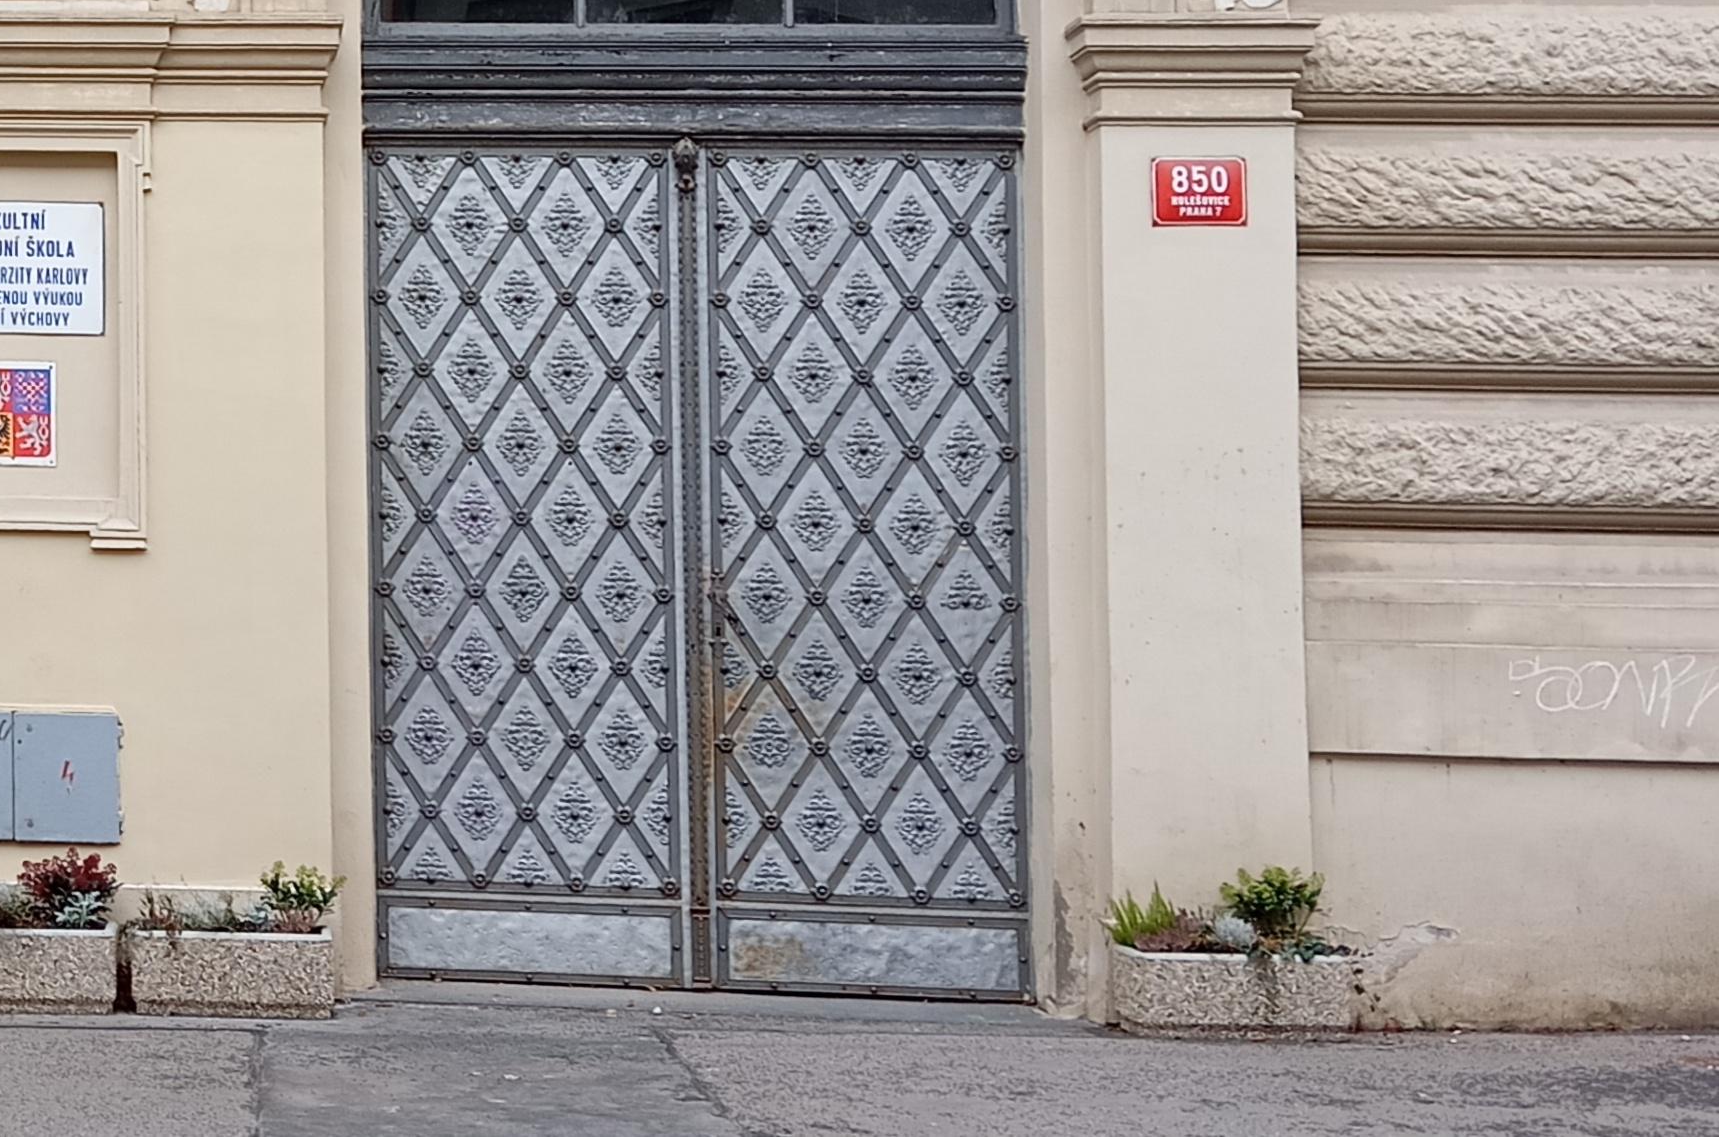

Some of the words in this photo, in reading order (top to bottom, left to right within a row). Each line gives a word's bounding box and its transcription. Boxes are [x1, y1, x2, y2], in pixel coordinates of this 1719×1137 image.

[1171, 165, 1229, 194] 850
[1179, 206, 1213, 217] PRAHA
[1215, 206, 1223, 217] 7
[26, 235, 76, 258] ŠKOLA
[36, 267, 89, 286] KARLOVY
[33, 288, 83, 306] VÝUKOU
[10, 308, 71, 327] VÝCHOVY
